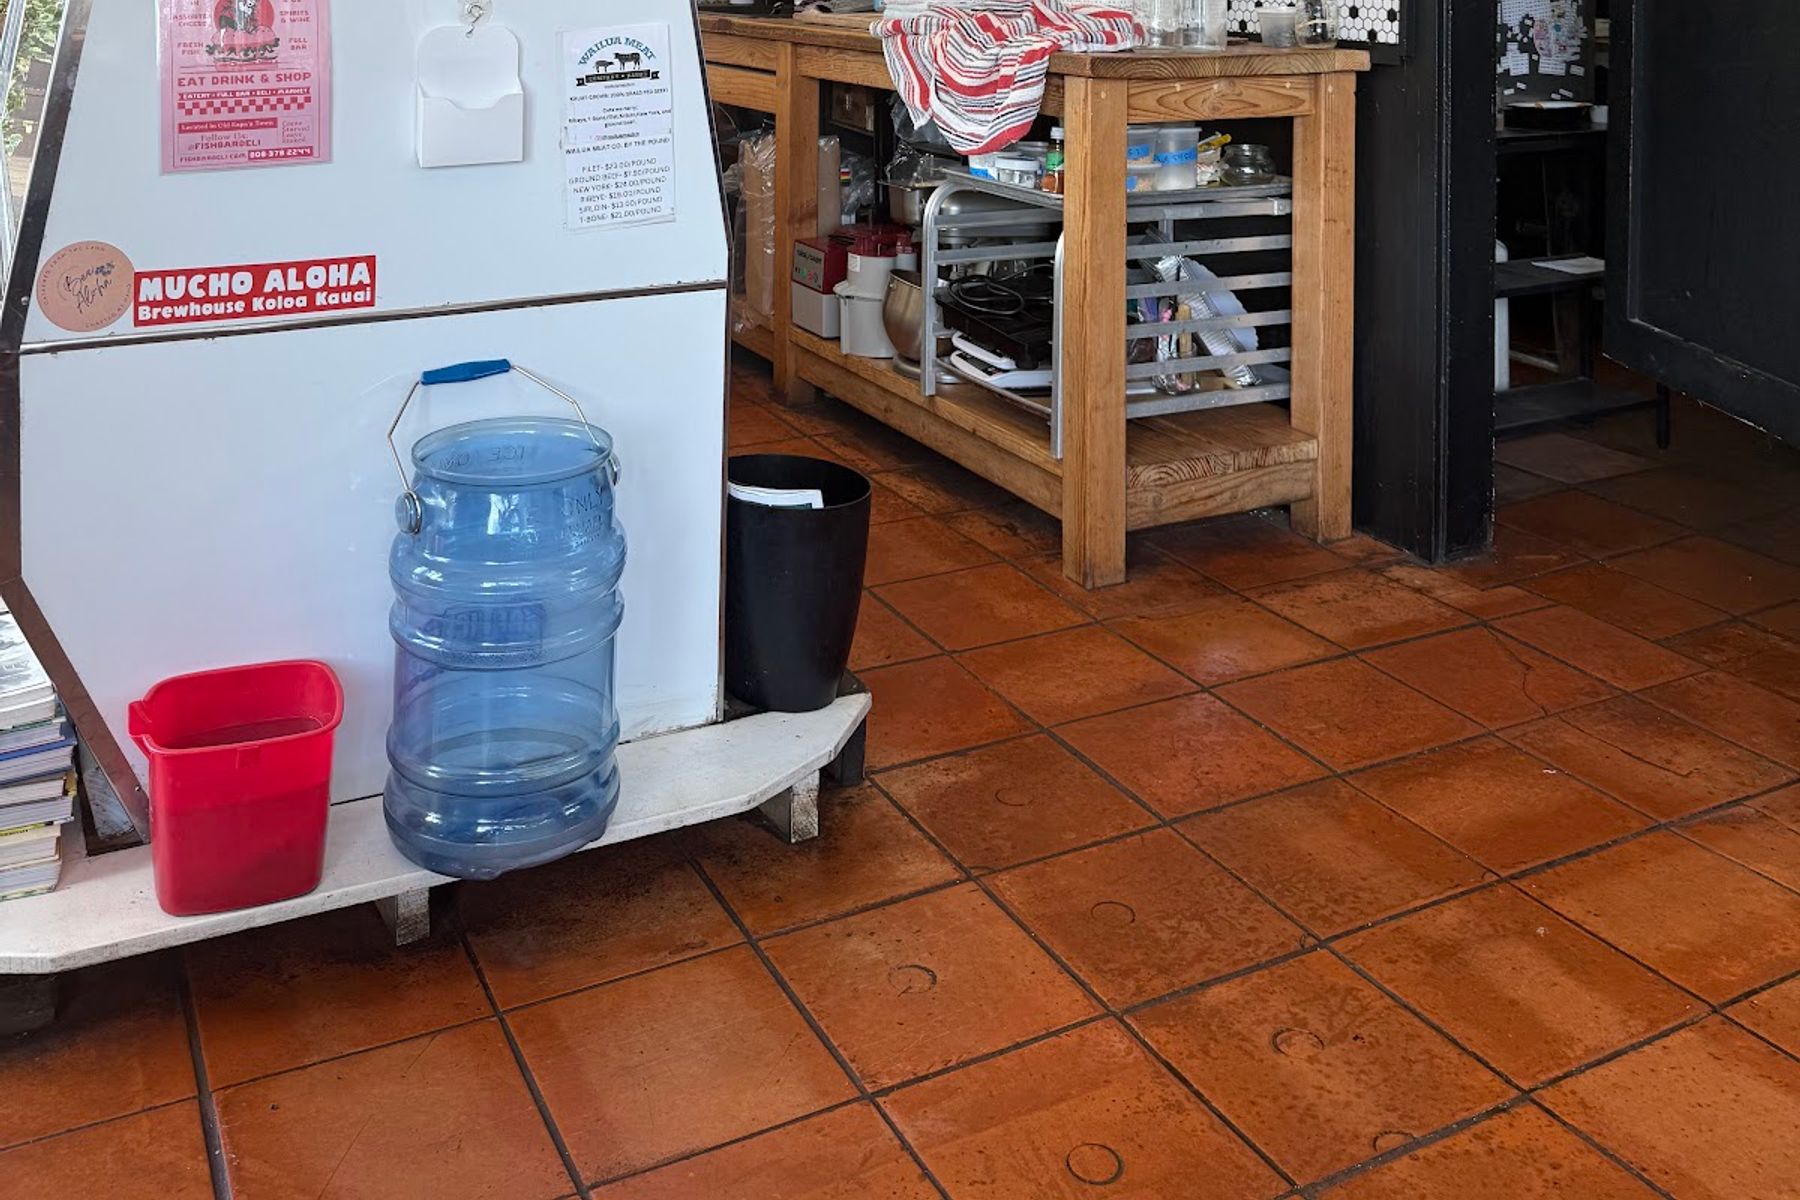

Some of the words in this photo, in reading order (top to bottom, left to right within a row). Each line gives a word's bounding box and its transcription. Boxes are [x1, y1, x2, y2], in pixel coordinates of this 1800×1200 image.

[577, 36, 623, 66] WAILUA
[624, 36, 657, 61] MEAT
[177, 76, 206, 87] EAT
[211, 74, 255, 85] DRINK
[260, 73, 270, 83] &
[275, 72, 312, 83] SHOP
[200, 133, 230, 141] Follow
[139, 272, 253, 302] MUCHO
[263, 262, 372, 292] ALOHA
[138, 300, 245, 321] Brewhouse
[252, 295, 308, 312] Koloa
[315, 287, 372, 305] Kauai
